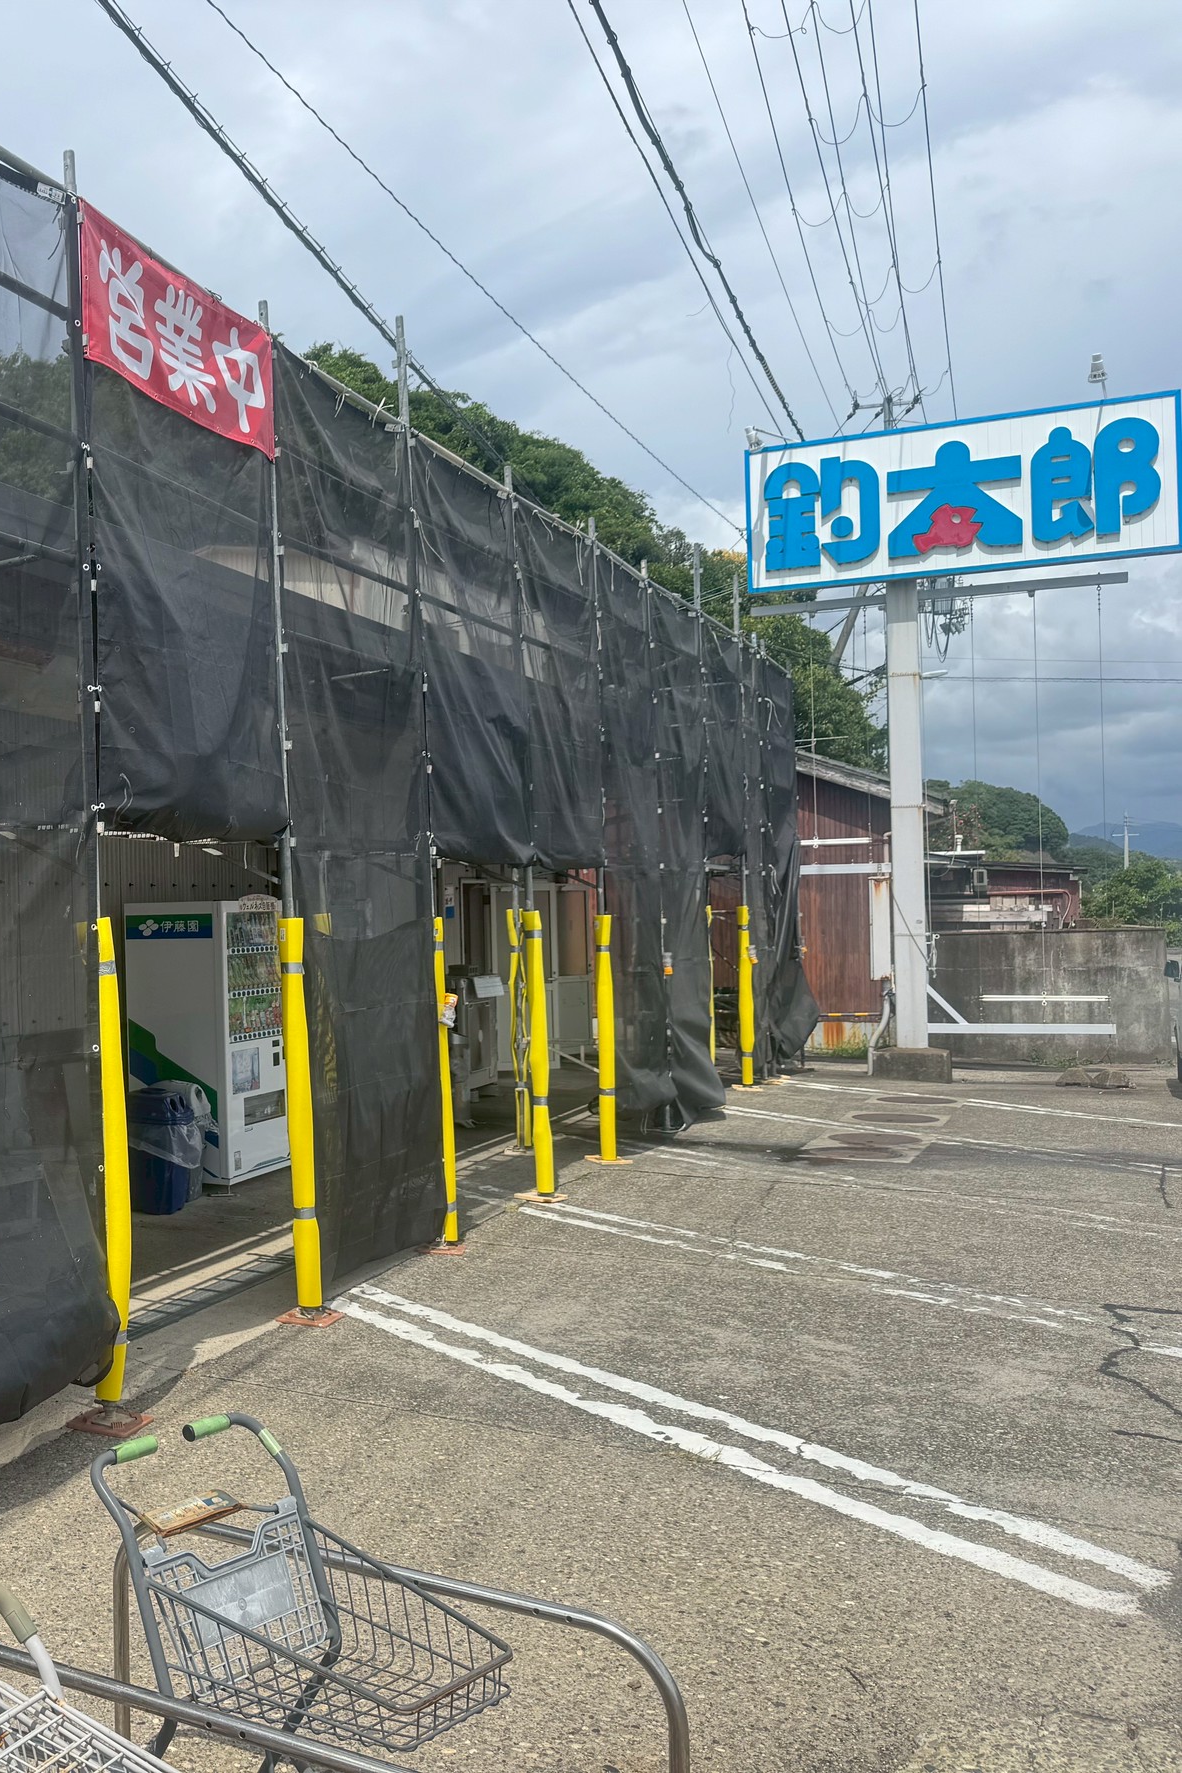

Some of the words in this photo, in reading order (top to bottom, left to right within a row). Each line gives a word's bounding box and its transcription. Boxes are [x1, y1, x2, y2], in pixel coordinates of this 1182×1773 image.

[99, 238, 266, 434] 営業中
[764, 417, 1161, 572] 釣太郎
[160, 920, 199, 933] 伊藤園
